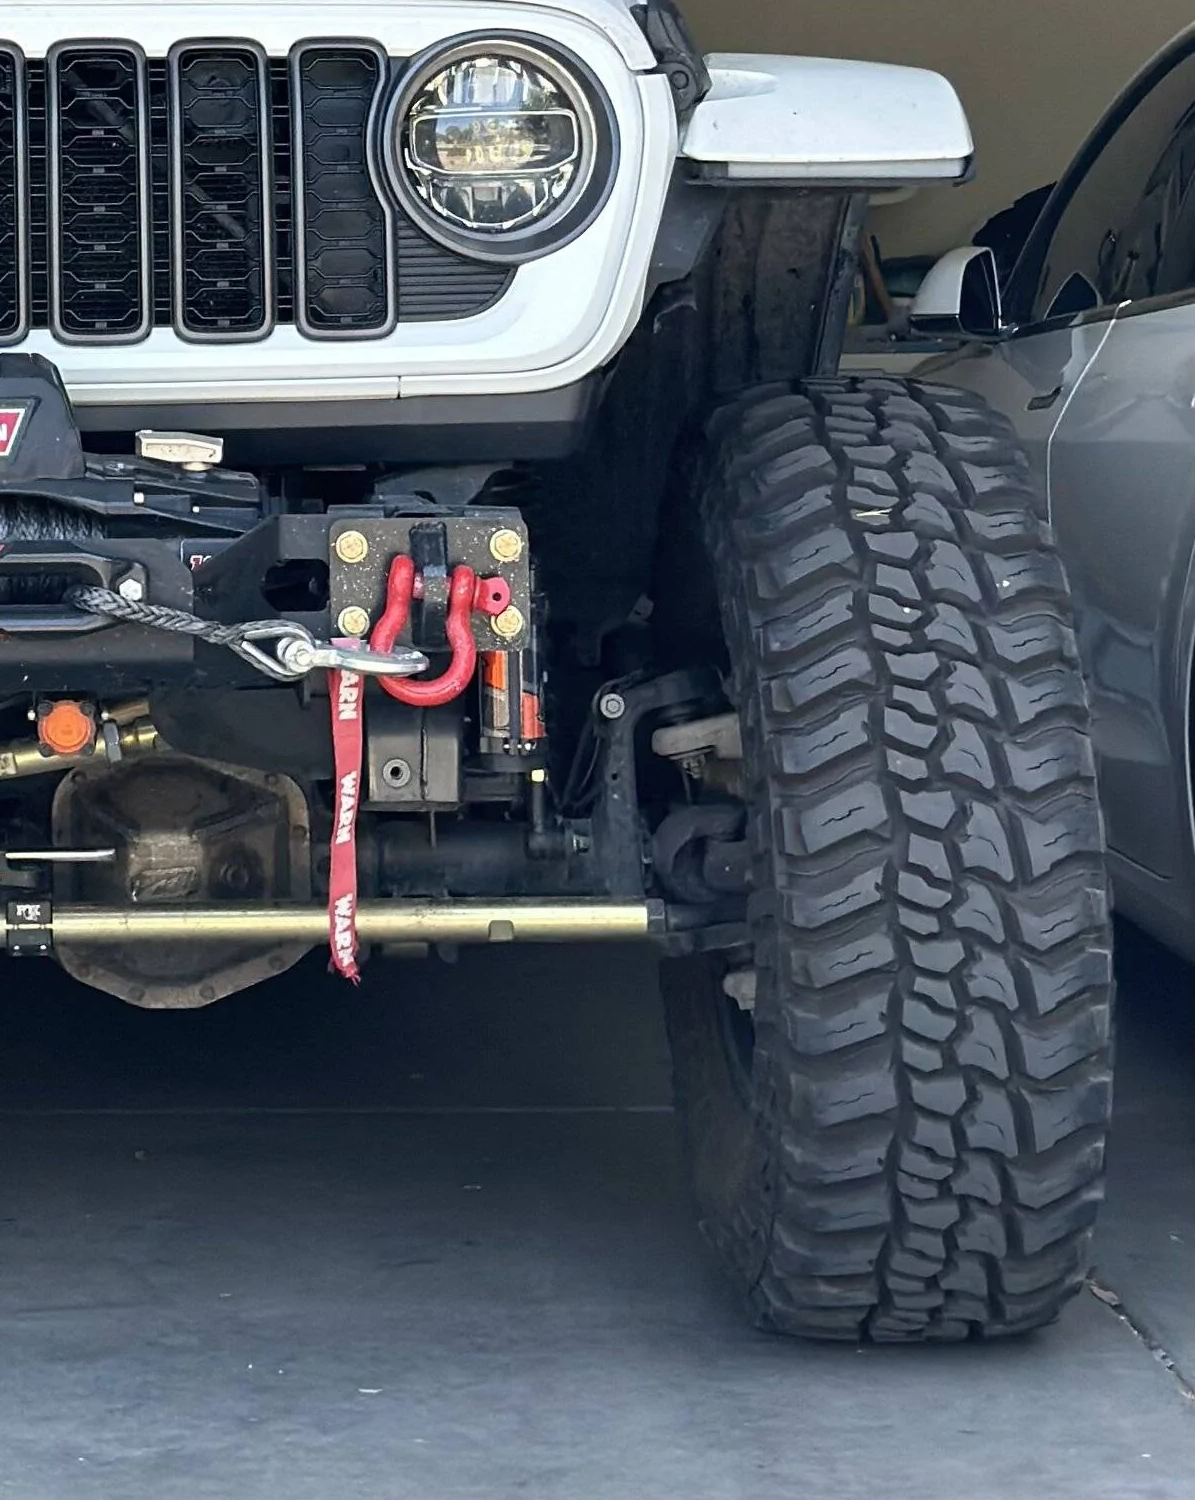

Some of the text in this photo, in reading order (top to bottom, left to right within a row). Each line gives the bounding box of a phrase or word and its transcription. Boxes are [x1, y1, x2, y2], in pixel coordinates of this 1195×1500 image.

[338, 668, 360, 721] ARN
[335, 770, 357, 845] WARN
[16, 903, 41, 921] FOX
[334, 892, 355, 968] WARN
